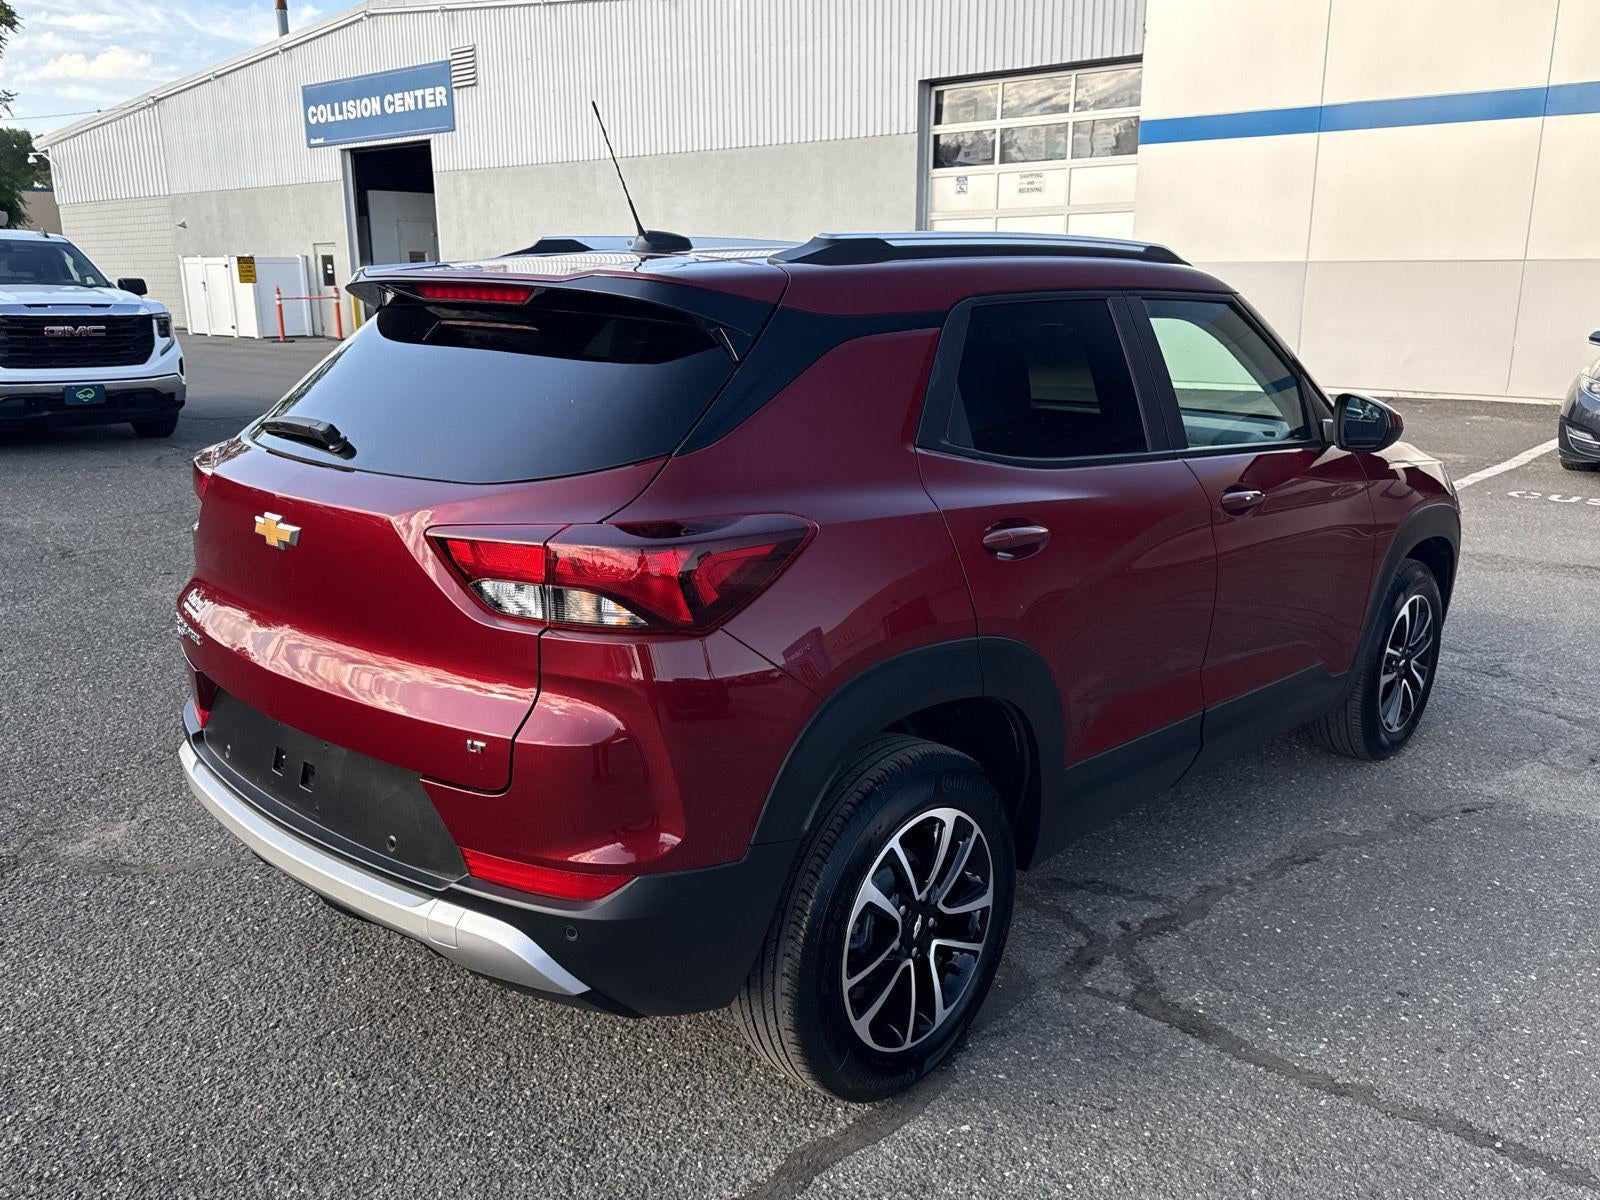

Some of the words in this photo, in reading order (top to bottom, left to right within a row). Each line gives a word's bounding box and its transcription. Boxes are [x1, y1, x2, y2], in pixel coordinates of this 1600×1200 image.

[307, 95, 382, 125] COLLISION
[384, 86, 448, 115] CENTER
[44, 325, 107, 338] GMC
[466, 739, 486, 754] LT
